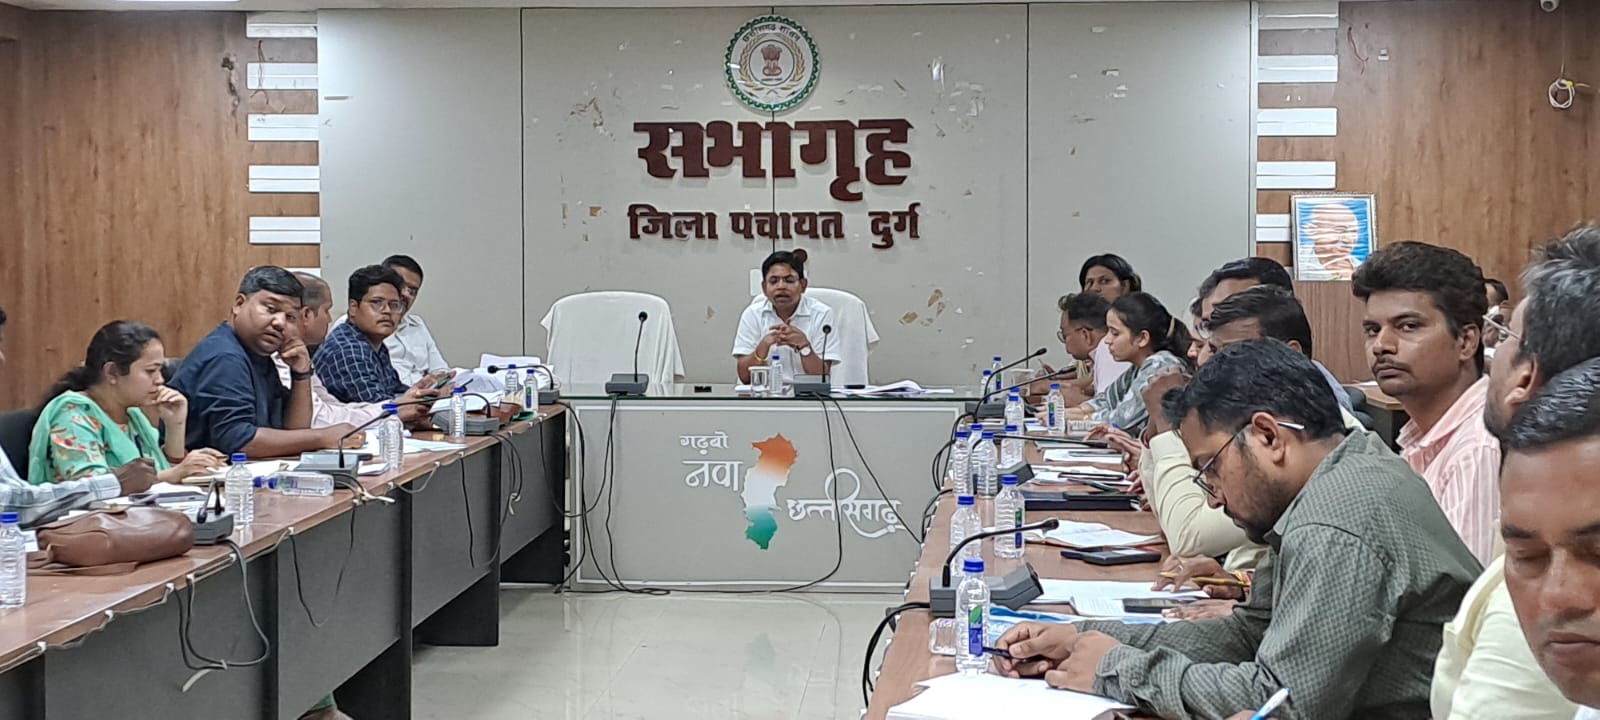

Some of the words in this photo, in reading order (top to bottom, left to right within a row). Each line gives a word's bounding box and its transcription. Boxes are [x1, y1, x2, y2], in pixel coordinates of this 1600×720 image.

[633, 119, 914, 201] सभागृह
[627, 204, 718, 240] जिला
[868, 203, 921, 249] दुर्ग
[682, 460, 744, 491] नवा
